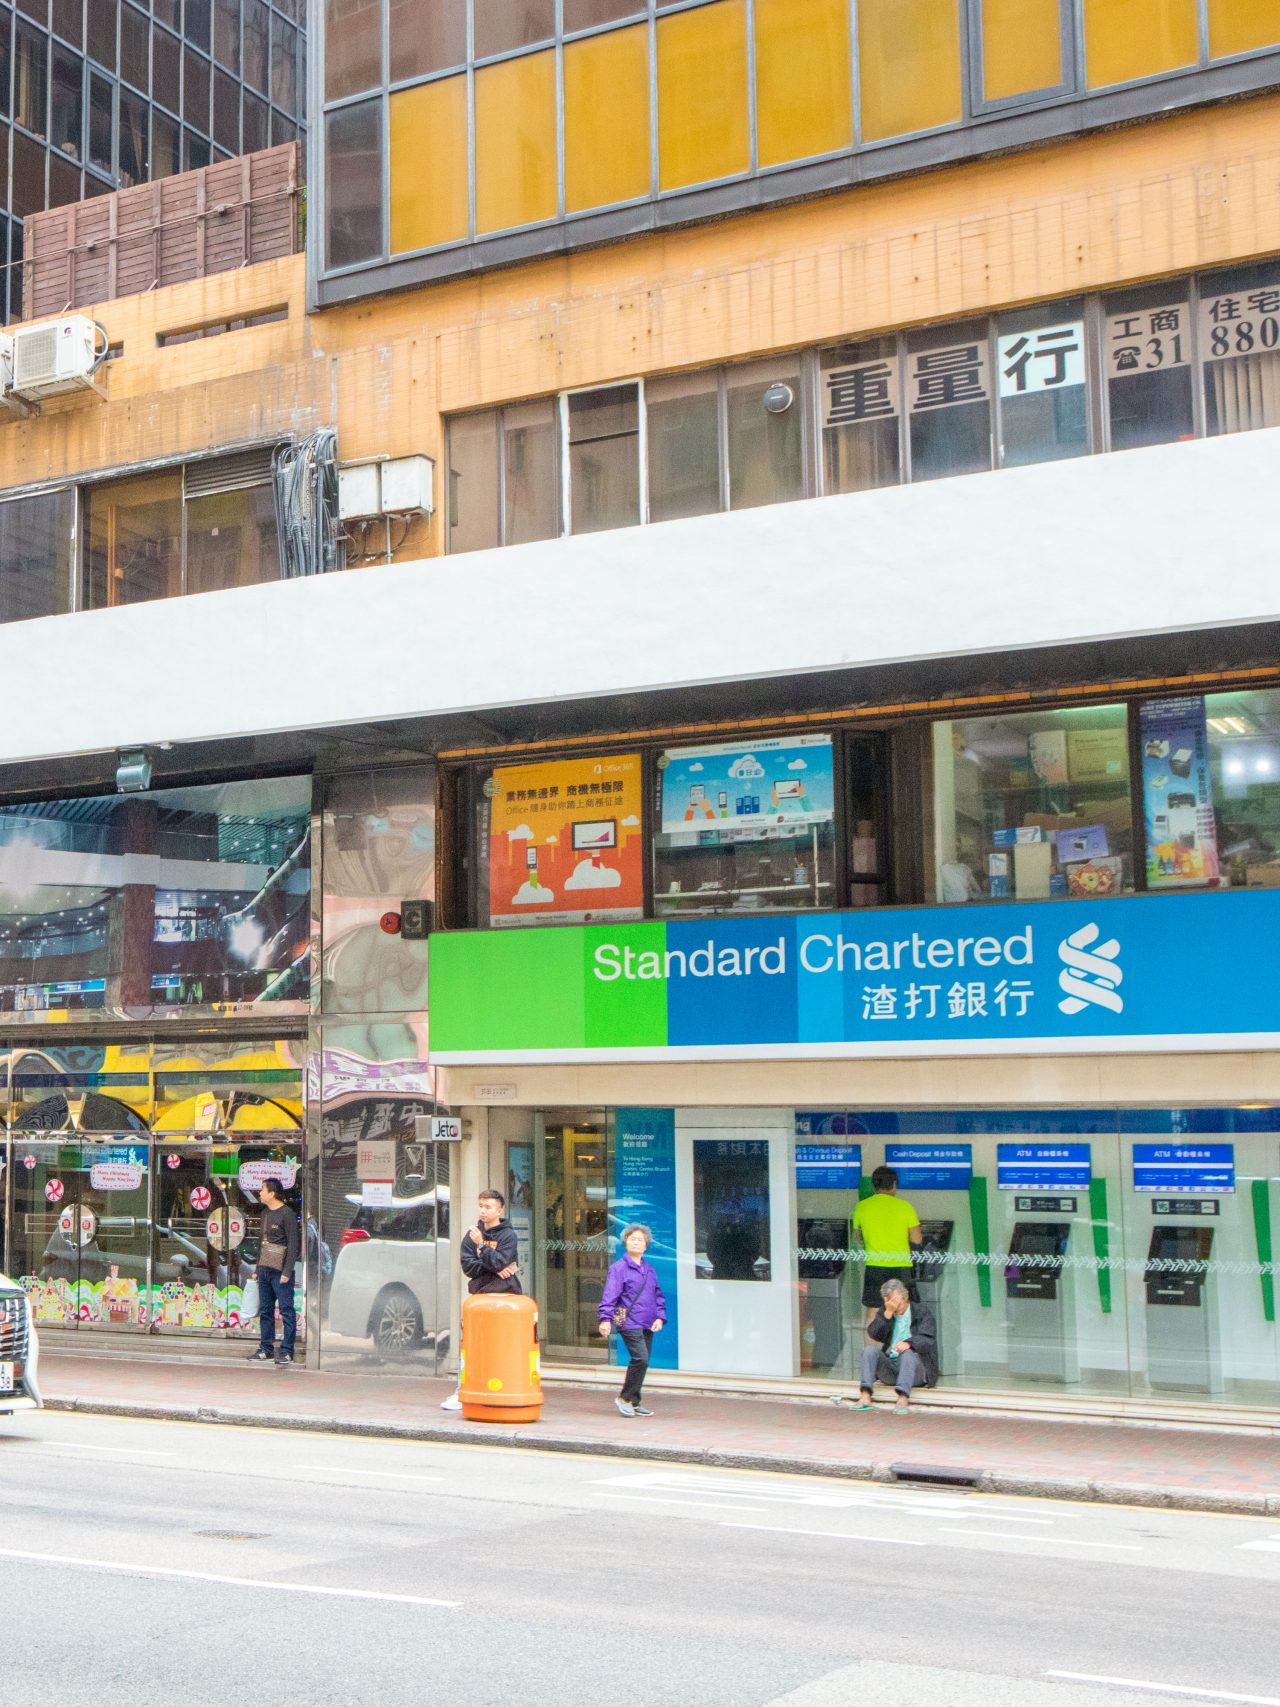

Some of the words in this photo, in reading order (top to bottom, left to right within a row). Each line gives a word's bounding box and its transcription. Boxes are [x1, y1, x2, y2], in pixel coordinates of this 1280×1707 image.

[1112, 309, 1181, 340] 工商
[1209, 289, 1280, 324] 住宅
[1145, 332, 1187, 369] 31
[1210, 316, 1280, 357] 880
[827, 329, 1080, 426] 重量行
[505, 804, 529, 816] Office
[593, 936, 787, 981] Standard
[800, 925, 1035, 975] Chartered
[861, 979, 1036, 1022] 渣打銀行
[622, 1133, 655, 1141] Welcome
[892, 1150, 909, 1158] Cash
[909, 1150, 932, 1159] Deposit
